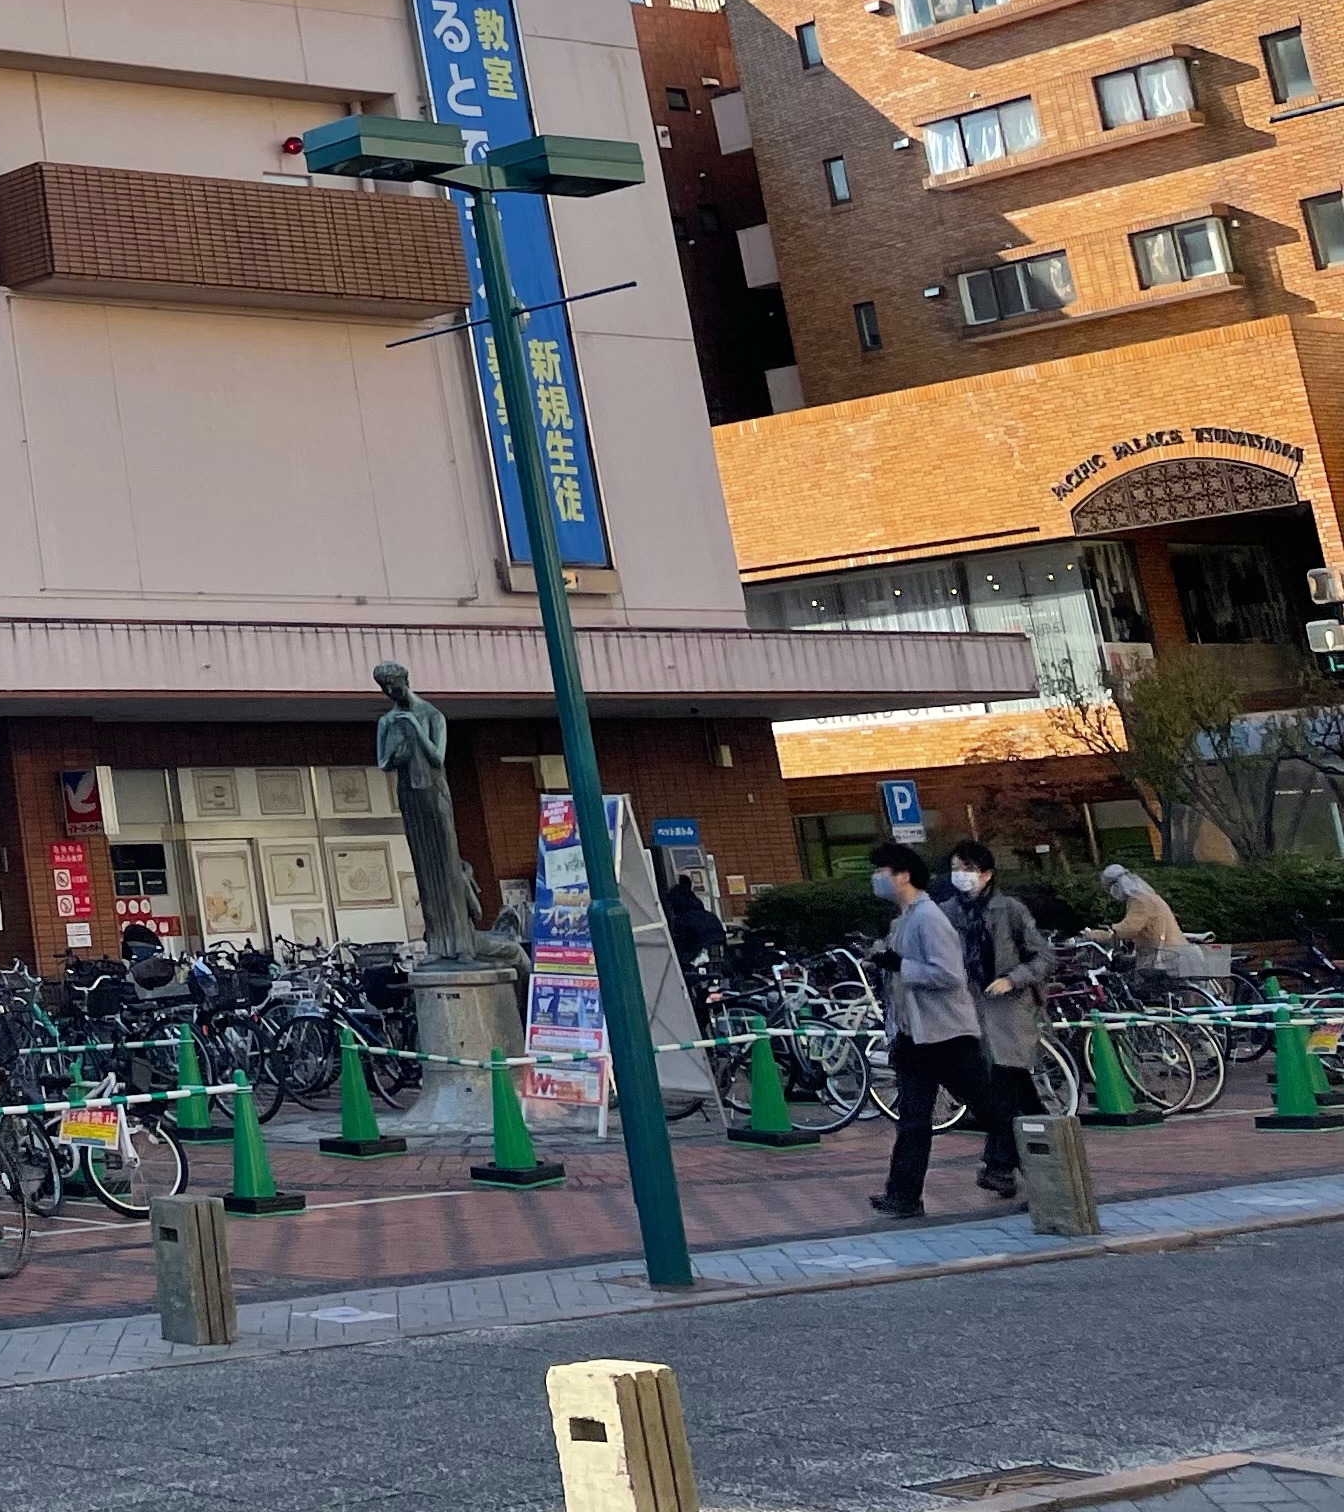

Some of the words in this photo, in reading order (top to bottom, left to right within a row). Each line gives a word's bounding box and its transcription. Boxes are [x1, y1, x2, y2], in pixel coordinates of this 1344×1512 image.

[528, 339, 585, 522] 新規生徒
[1111, 429, 1185, 461] PALACE
[892, 786, 912, 820] P
